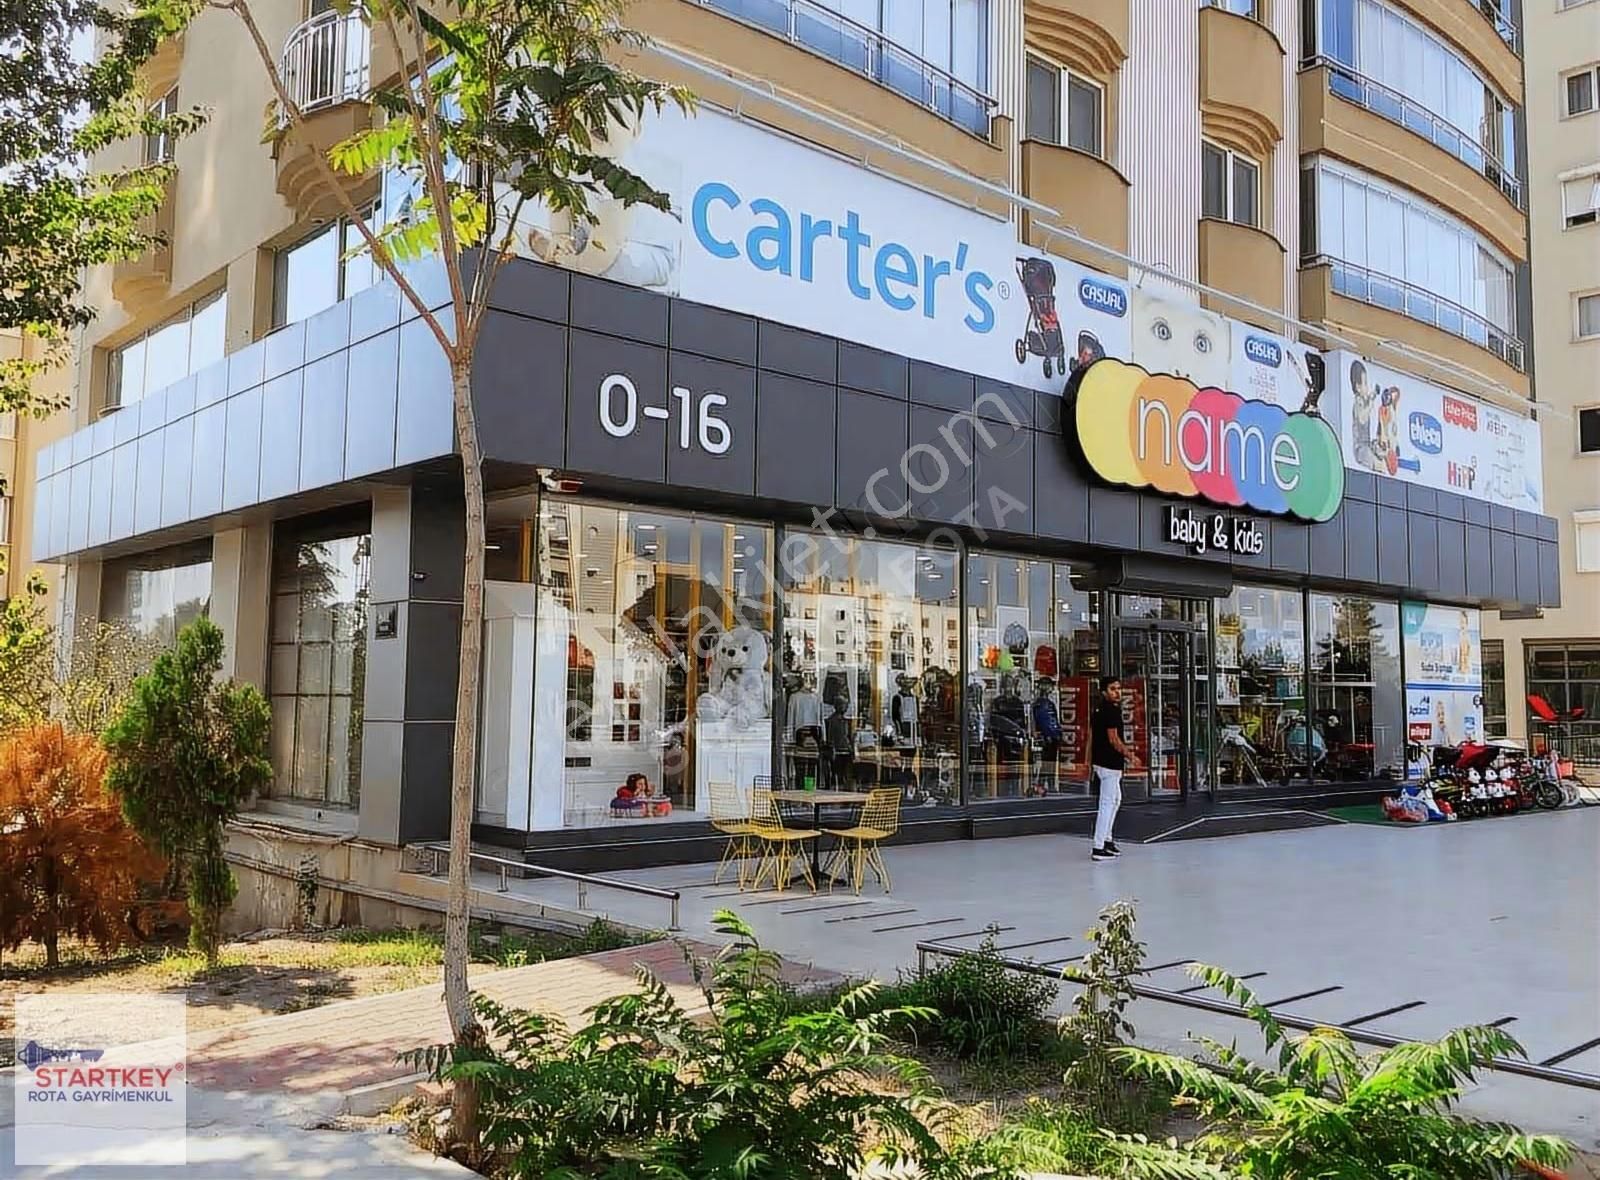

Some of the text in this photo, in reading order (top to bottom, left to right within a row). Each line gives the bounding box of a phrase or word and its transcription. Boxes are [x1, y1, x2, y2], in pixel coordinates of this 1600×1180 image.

[691, 182, 996, 334] carter's
[1081, 283, 1123, 311] CASUAL
[1246, 340, 1279, 362] CASUAL
[599, 373, 733, 455] 0-16
[1137, 393, 1300, 492] name
[1170, 506, 1263, 554] baby & kids
